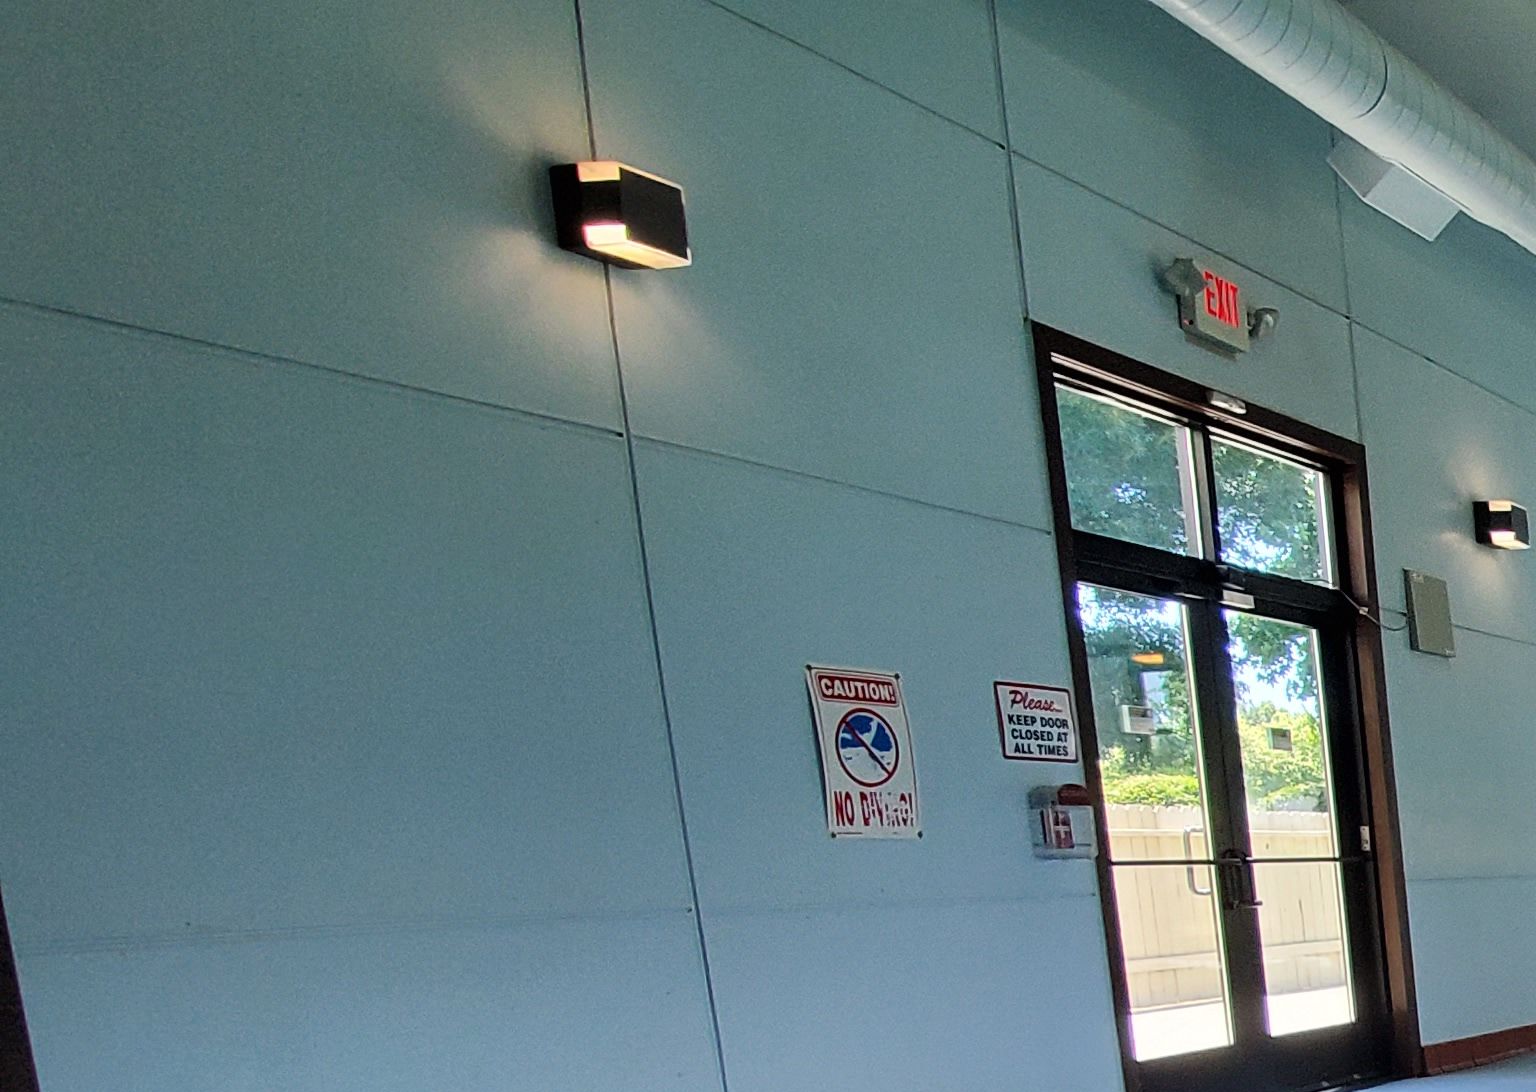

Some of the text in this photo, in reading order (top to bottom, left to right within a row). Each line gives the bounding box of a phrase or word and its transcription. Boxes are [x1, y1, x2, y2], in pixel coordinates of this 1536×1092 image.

[1203, 271, 1240, 328] EXIT
[820, 678, 896, 702] CAUTION!
[1007, 713, 1069, 730] KEEP DOOR
[1010, 728, 1069, 743] CLOSED AT
[1013, 742, 1069, 757] ALL TIMES
[833, 790, 855, 827] NO
